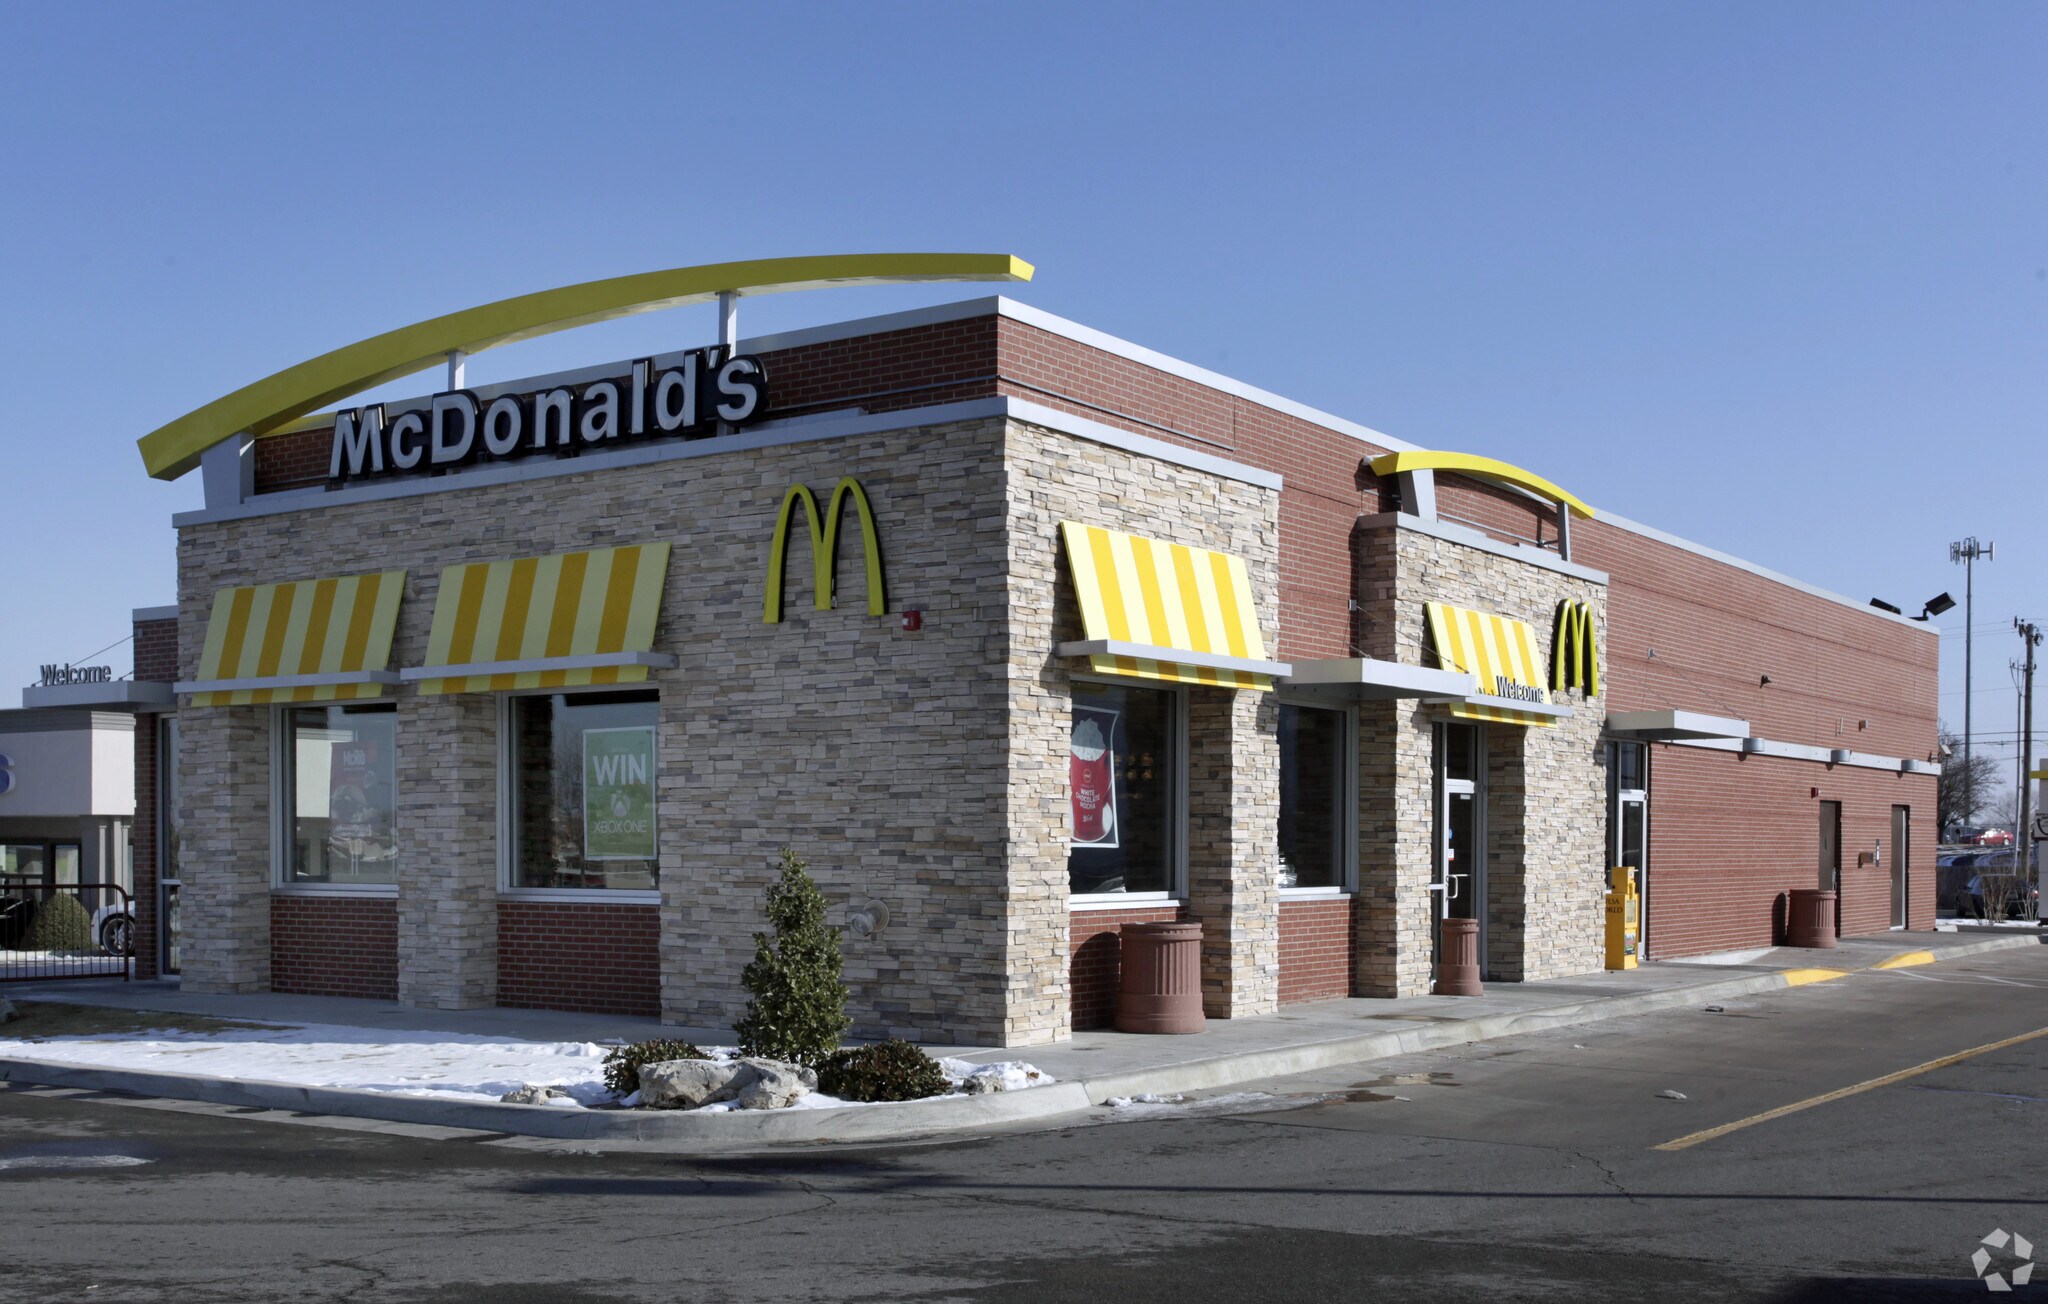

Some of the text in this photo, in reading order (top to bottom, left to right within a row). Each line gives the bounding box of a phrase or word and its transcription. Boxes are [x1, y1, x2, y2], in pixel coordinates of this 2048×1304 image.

[329, 344, 767, 481] McDonald's
[40, 663, 112, 687] Welcome
[1496, 675, 1544, 703] Welcome
[592, 753, 647, 786] WIN
[1080, 788, 1095, 797] WHITE
[593, 820, 647, 833] XBOX ONE
